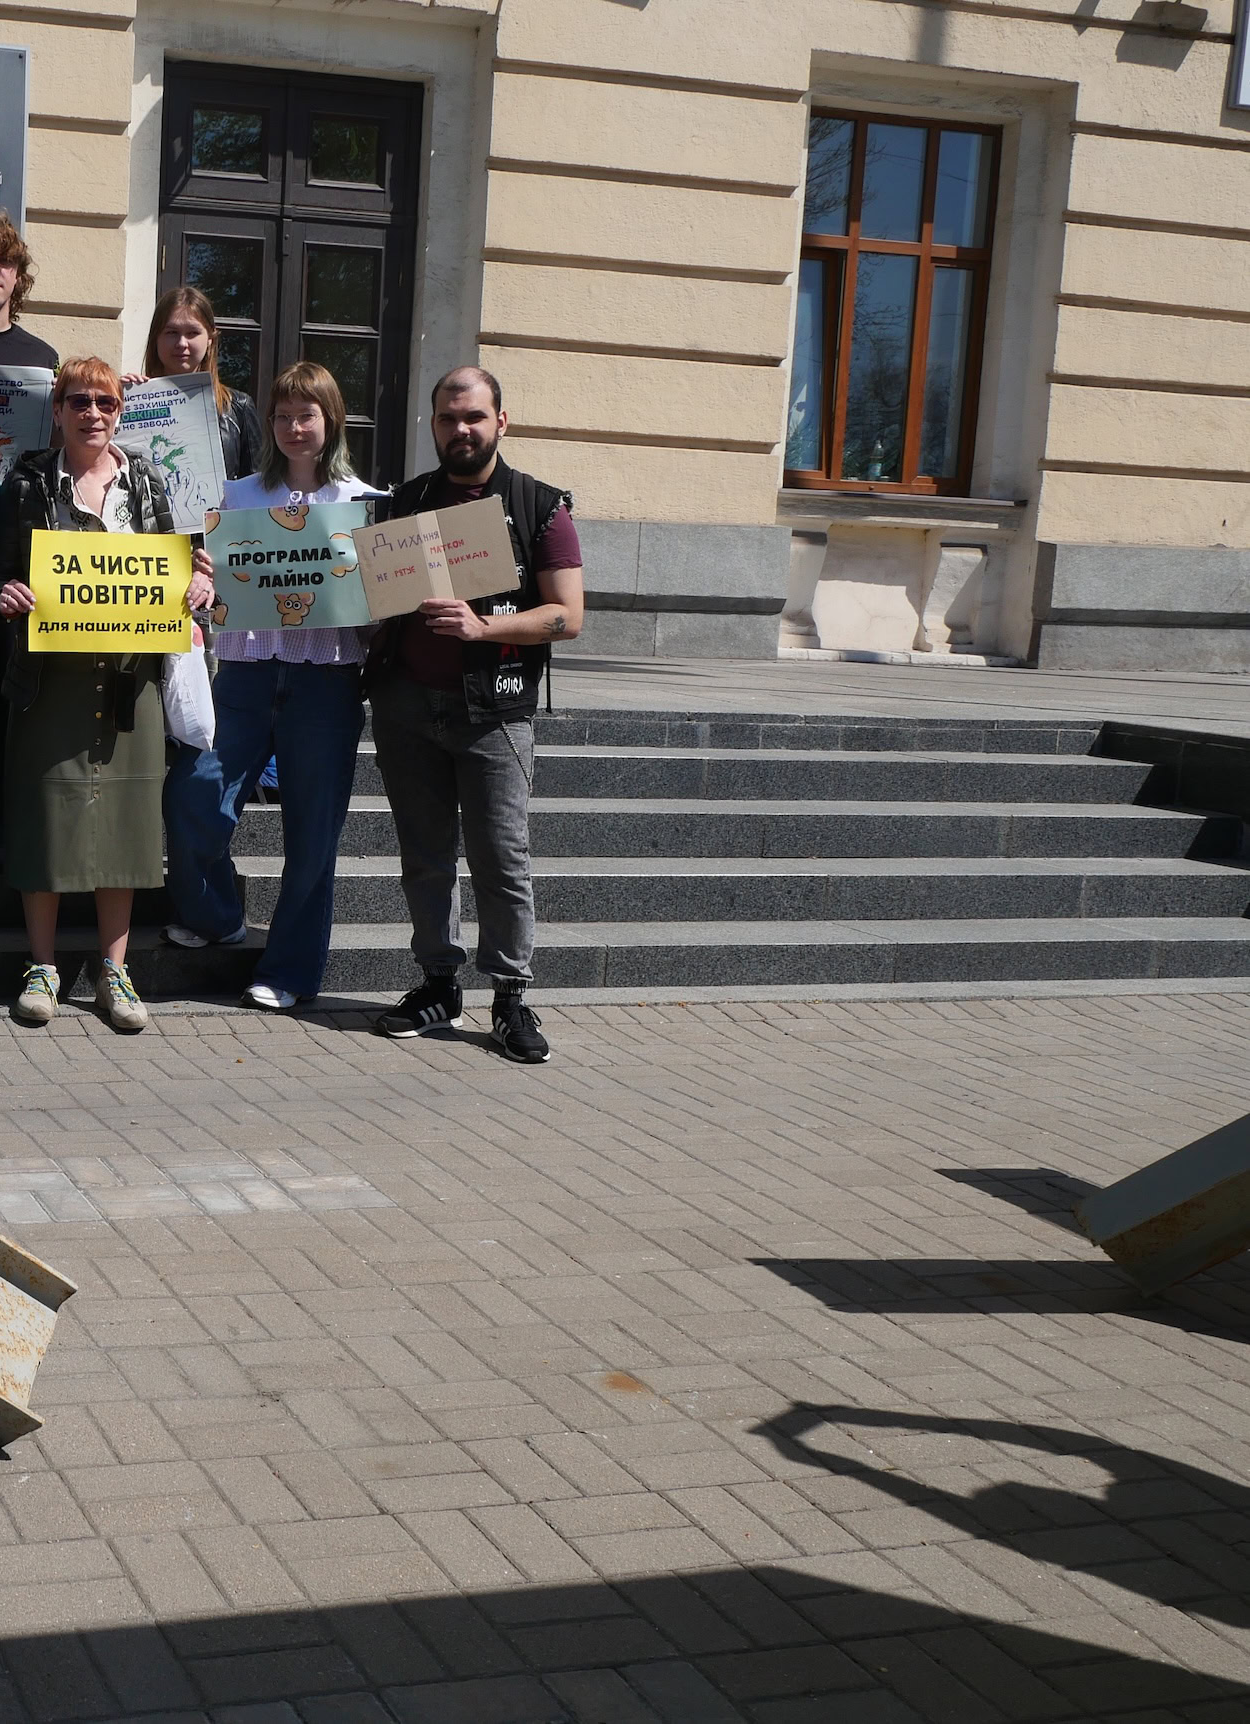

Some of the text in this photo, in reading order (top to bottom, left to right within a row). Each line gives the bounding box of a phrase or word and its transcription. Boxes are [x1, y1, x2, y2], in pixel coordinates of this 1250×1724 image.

[121, 408, 168, 421] ОВКІЛЛЯ
[133, 398, 186, 411] захищати
[138, 418, 179, 429] заводи.
[52, 555, 169, 576] ЗА ЧИСТЕ
[228, 547, 333, 567] ПРОГРАМА
[376, 572, 388, 582] НЕ
[448, 550, 489, 565] ВИКИДІВ
[257, 569, 324, 589] ЛАЙНО
[59, 584, 164, 605] ПОВІТРЯ
[38, 619, 182, 635] для наших дітей!
[495, 675, 524, 695] GOJIRA
